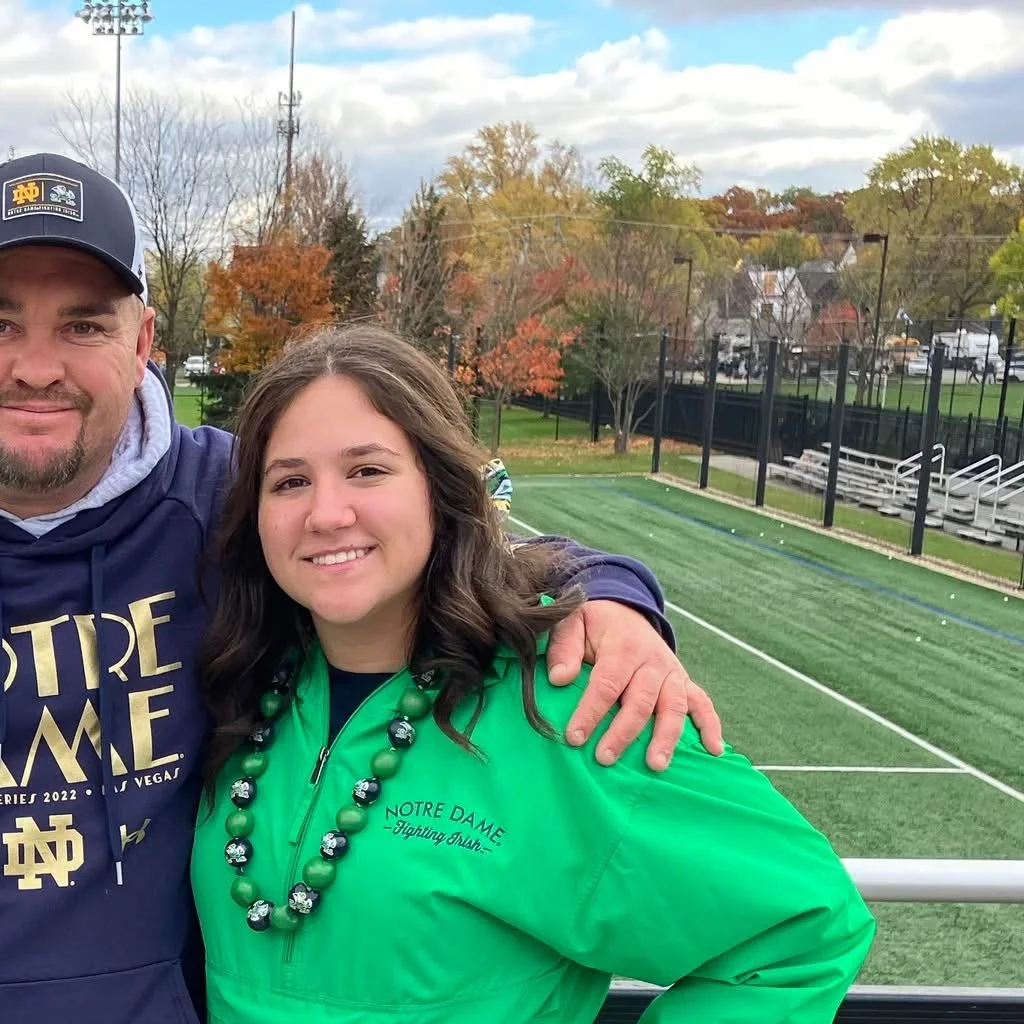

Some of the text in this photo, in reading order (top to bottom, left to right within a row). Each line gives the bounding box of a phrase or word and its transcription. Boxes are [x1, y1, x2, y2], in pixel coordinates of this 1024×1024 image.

[43, 790, 77, 803] 2022
[134, 767, 181, 789] VEGAS
[385, 801, 505, 844] NOTRE DAME
[392, 820, 484, 853] Fighting Irish
